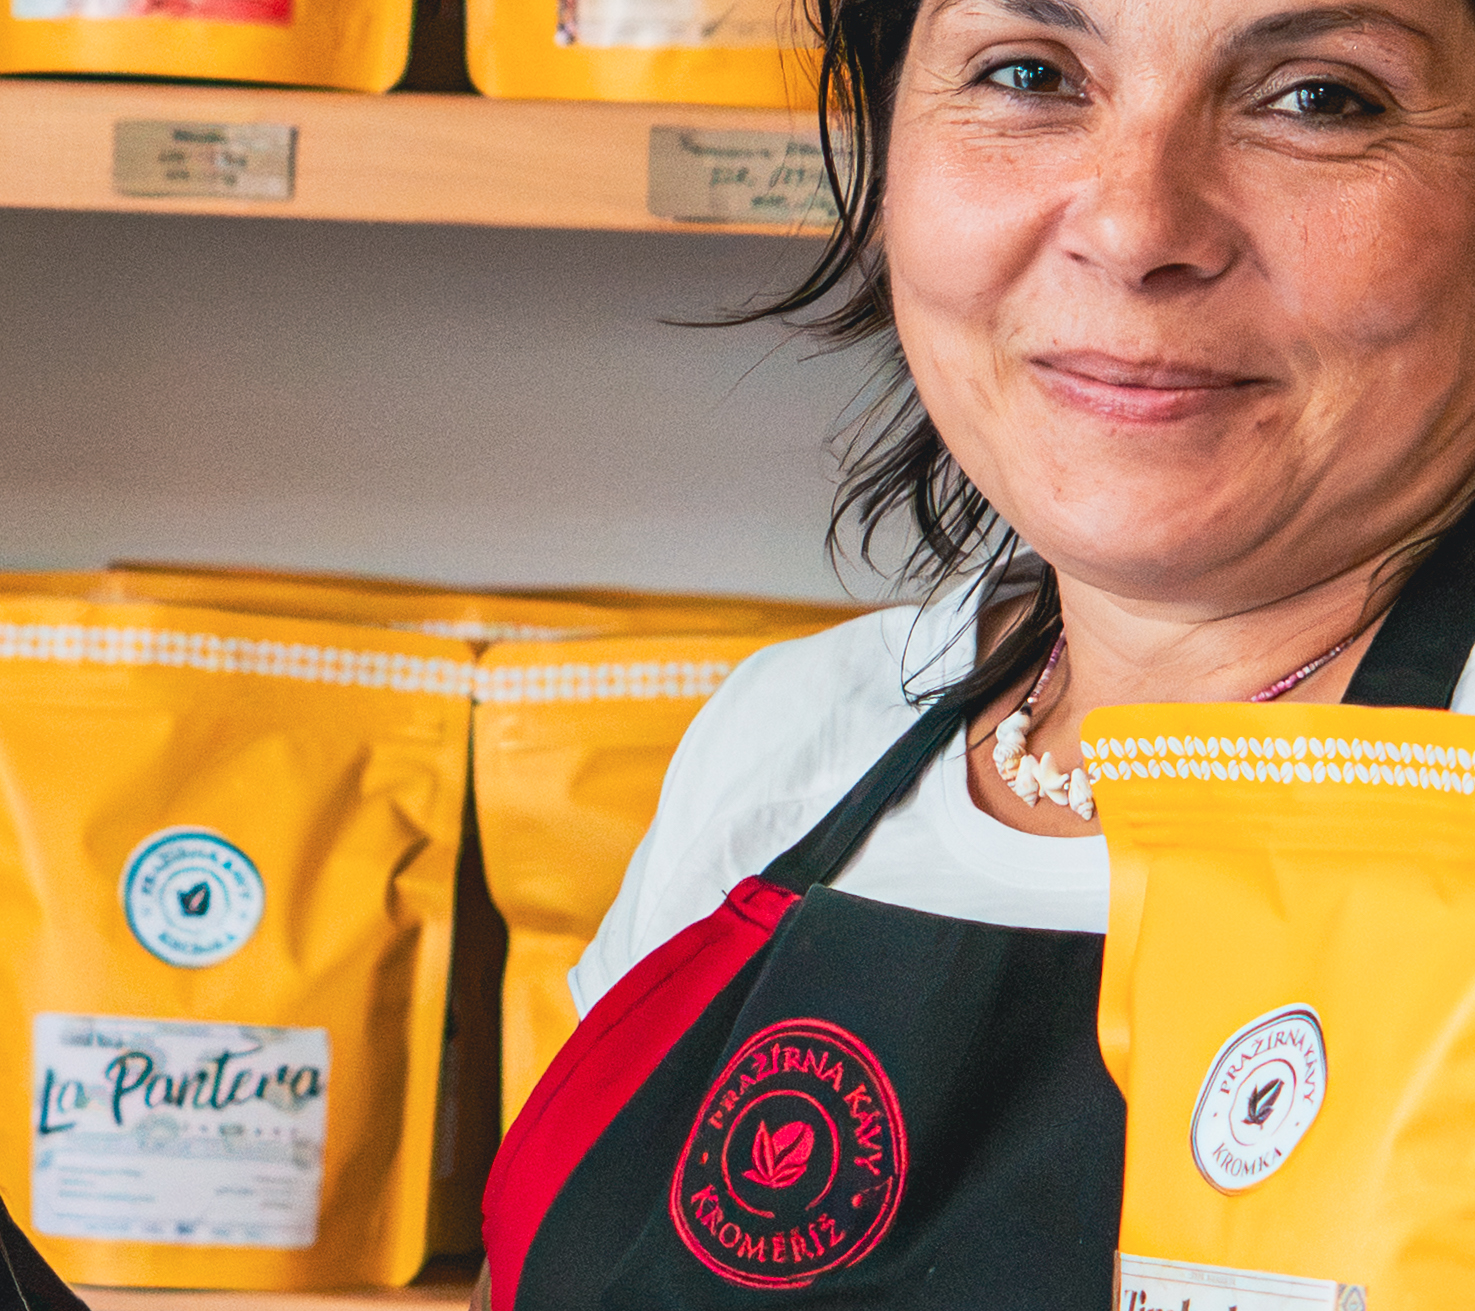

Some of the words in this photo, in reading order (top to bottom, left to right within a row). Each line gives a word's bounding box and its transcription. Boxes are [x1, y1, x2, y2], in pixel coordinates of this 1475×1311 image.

[39, 1067, 84, 1134] La
[105, 1046, 322, 1126] Pantera
[1219, 1029, 1307, 1095] PRAŽÍRNA
[1212, 1142, 1283, 1177] KROMKA
